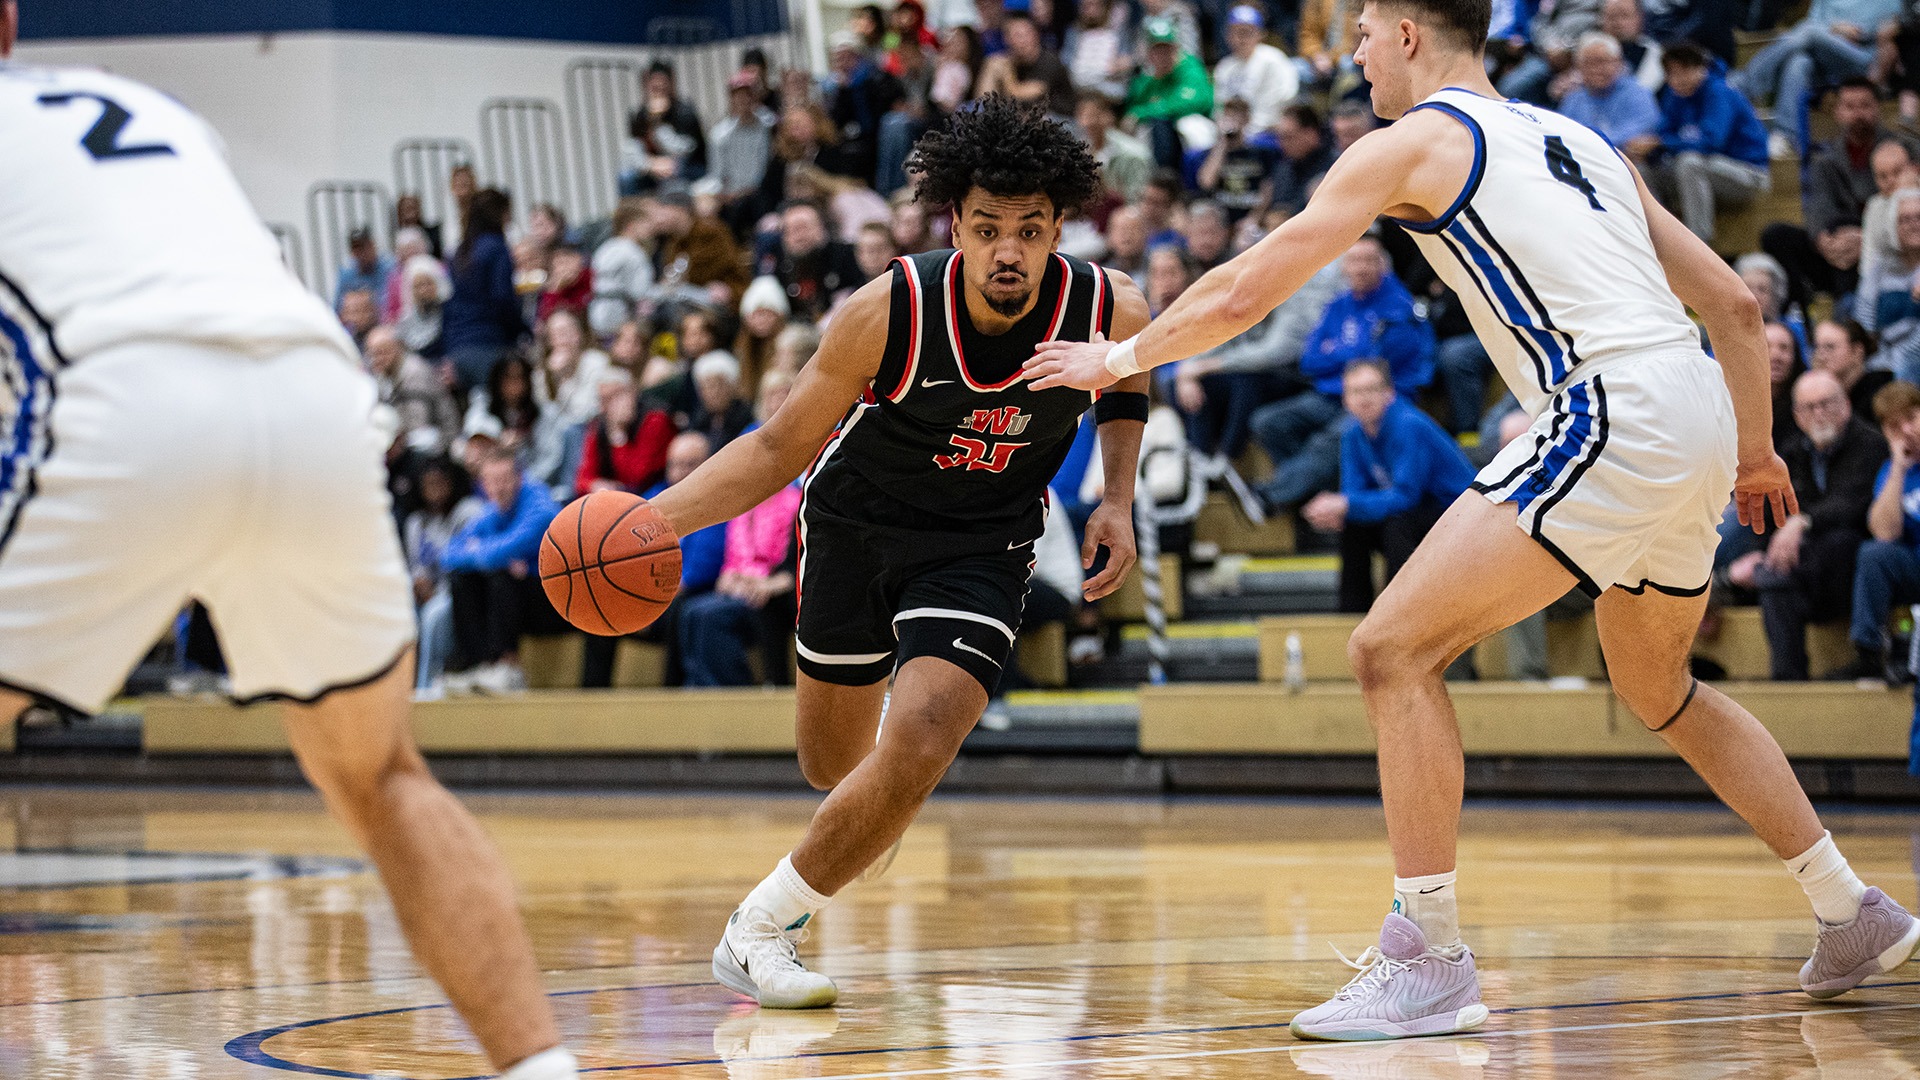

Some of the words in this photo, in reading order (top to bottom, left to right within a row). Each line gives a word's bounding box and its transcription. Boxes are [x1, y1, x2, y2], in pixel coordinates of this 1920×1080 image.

[37, 92, 177, 162] 2
[1543, 134, 1607, 212] 4
[957, 405, 1032, 435] IWU
